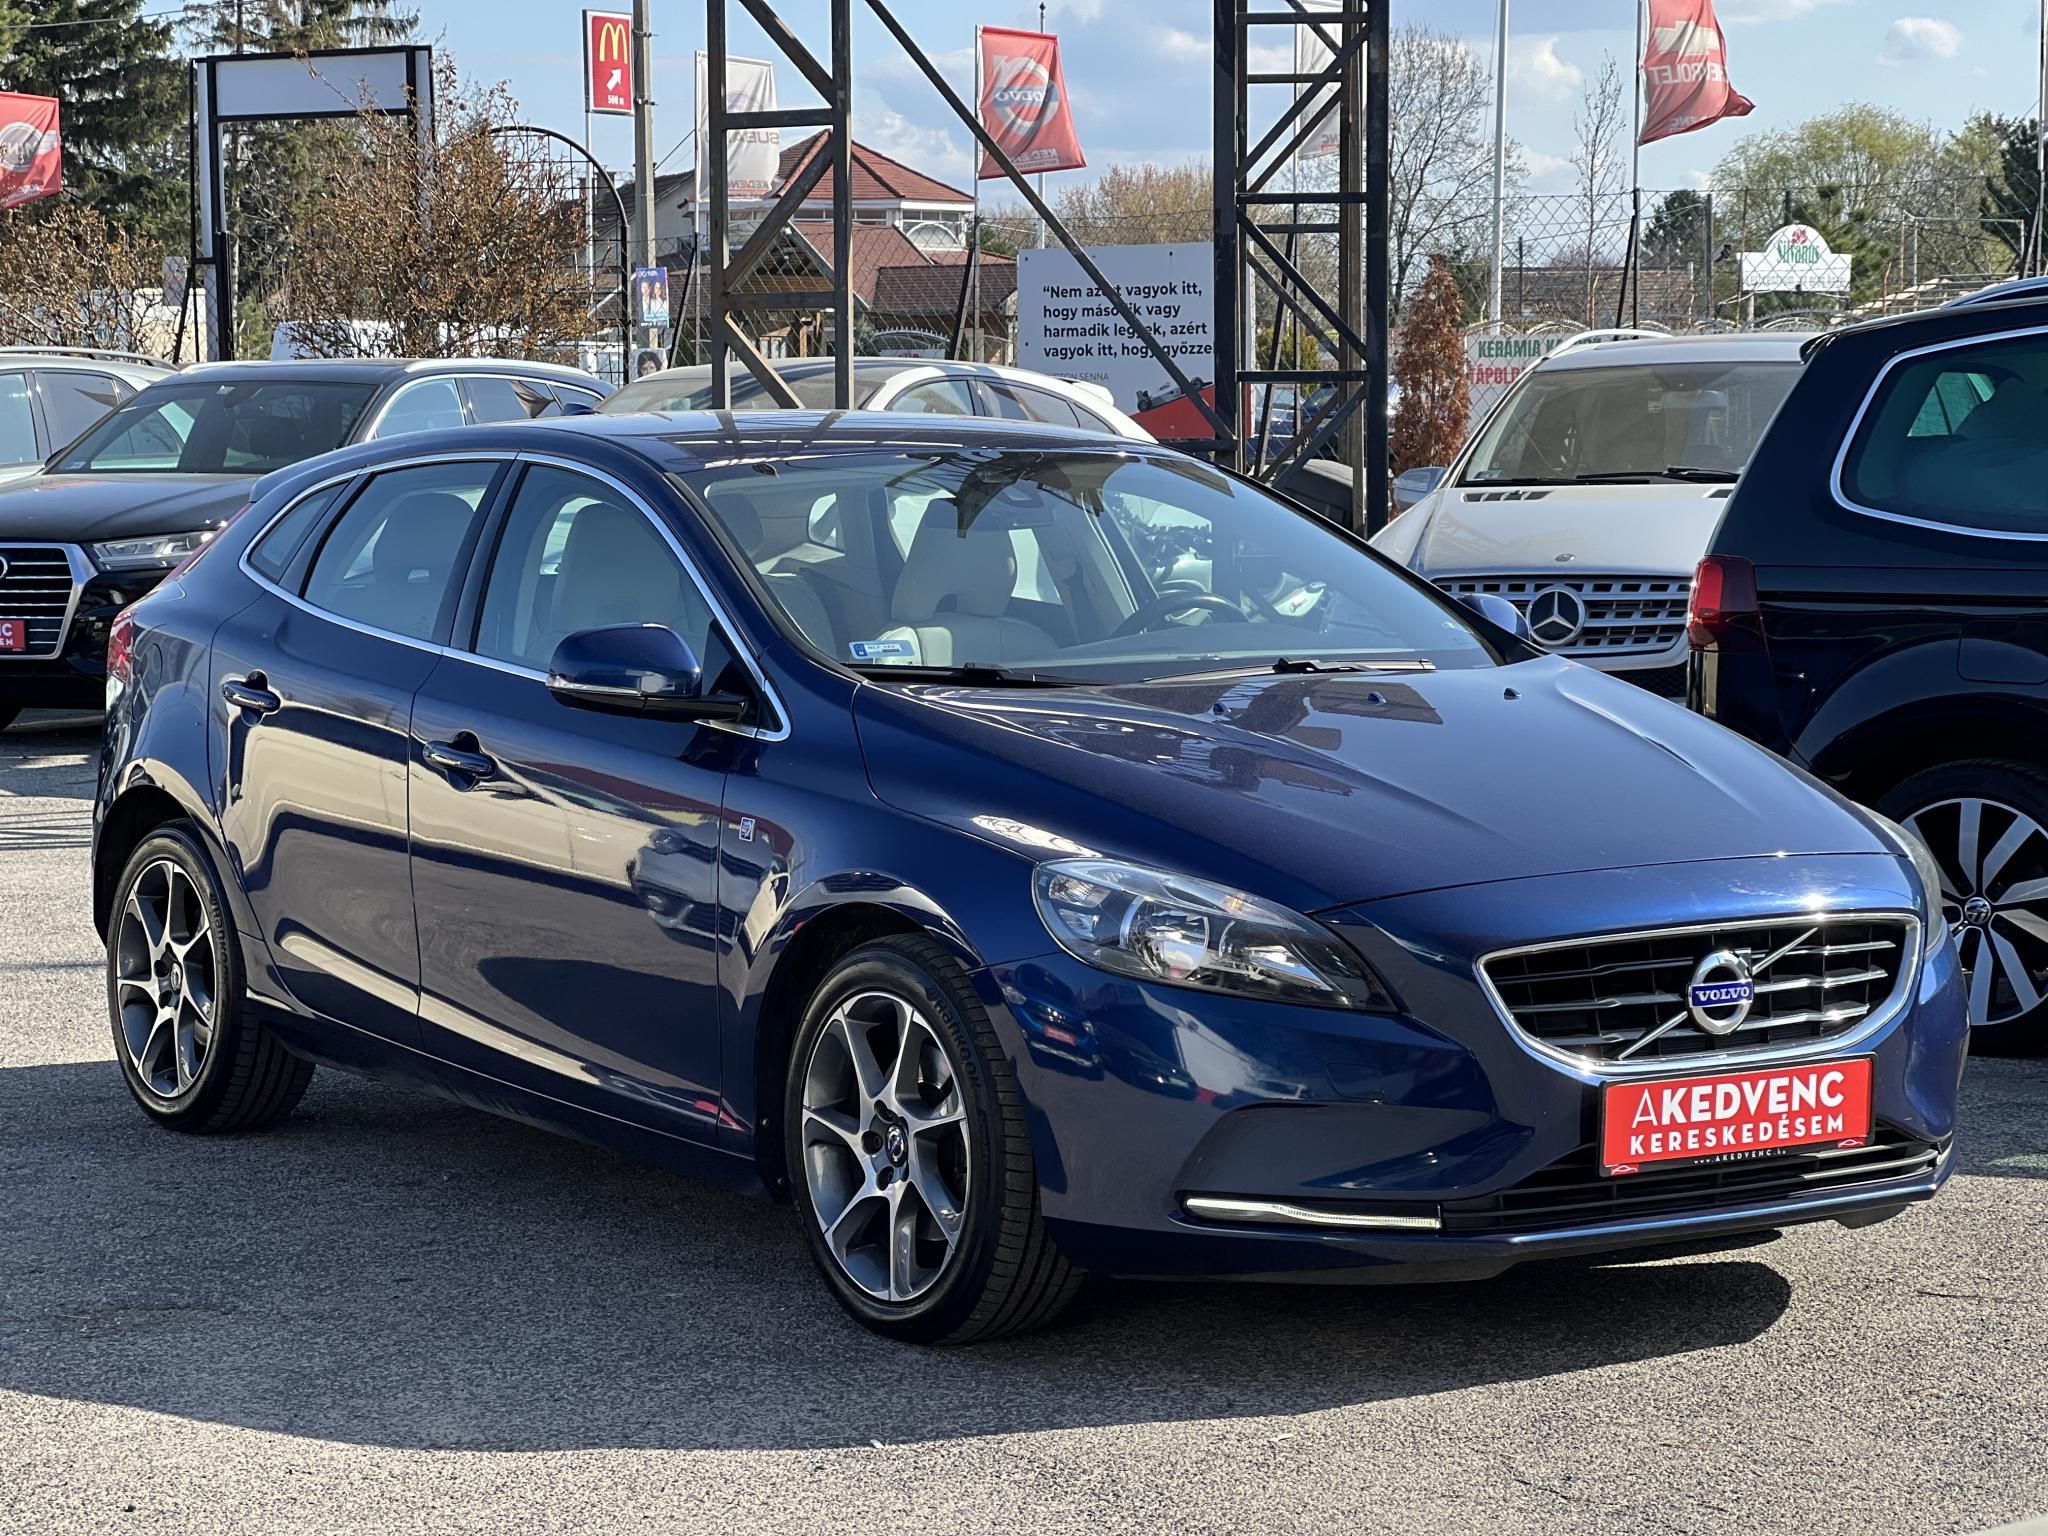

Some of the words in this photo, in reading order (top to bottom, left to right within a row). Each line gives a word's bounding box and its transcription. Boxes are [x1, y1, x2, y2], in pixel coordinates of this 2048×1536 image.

[1086, 284, 1122, 297] azt
[1126, 282, 1178, 300] vagyok
[1182, 280, 1202, 297] itt,
[1043, 305, 1078, 321] hogy
[1081, 303, 1143, 317] másoik
[1146, 304, 1181, 318] vagy
[1044, 322, 1110, 338] harmadik
[1170, 321, 1208, 335] azért
[1044, 343, 1093, 360] vagyok
[1098, 342, 1117, 358] itt,
[1165, 341, 1214, 359] győzze
[1079, 372, 1110, 381] SENNA
[1695, 986, 1750, 1002] VOLVO
[1630, 1112, 1843, 1156] KERESKEDÉSEM
